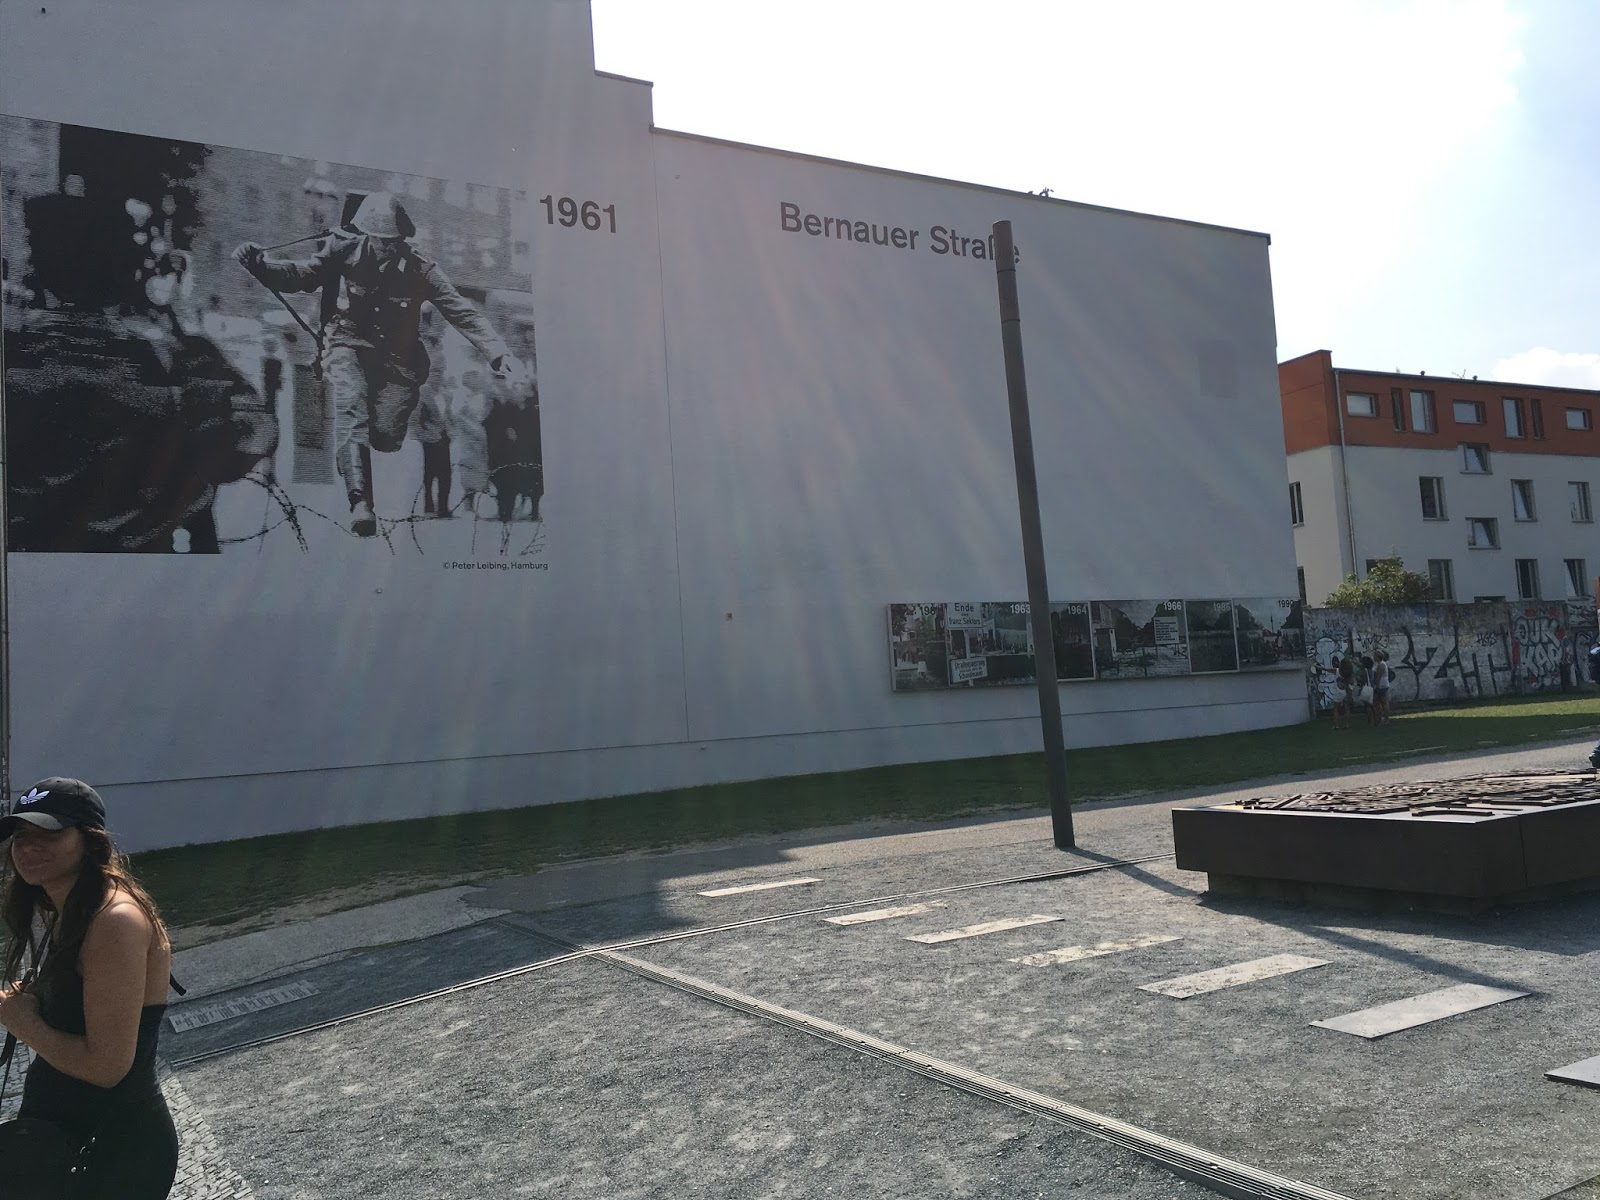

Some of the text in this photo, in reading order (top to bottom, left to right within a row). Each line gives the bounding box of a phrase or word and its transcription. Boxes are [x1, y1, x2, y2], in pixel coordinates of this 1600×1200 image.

[540, 194, 617, 234] 1961
[781, 202, 1020, 264] Bernauer Stra
[477, 562, 509, 570] Leibing,
[511, 562, 549, 570] Hamburg
[920, 606, 939, 615] 196
[955, 602, 974, 612] Ende
[1010, 604, 1030, 614] 1963
[1067, 605, 1087, 614] 1964
[1163, 602, 1182, 611] 1966
[1213, 602, 1231, 611] 1986
